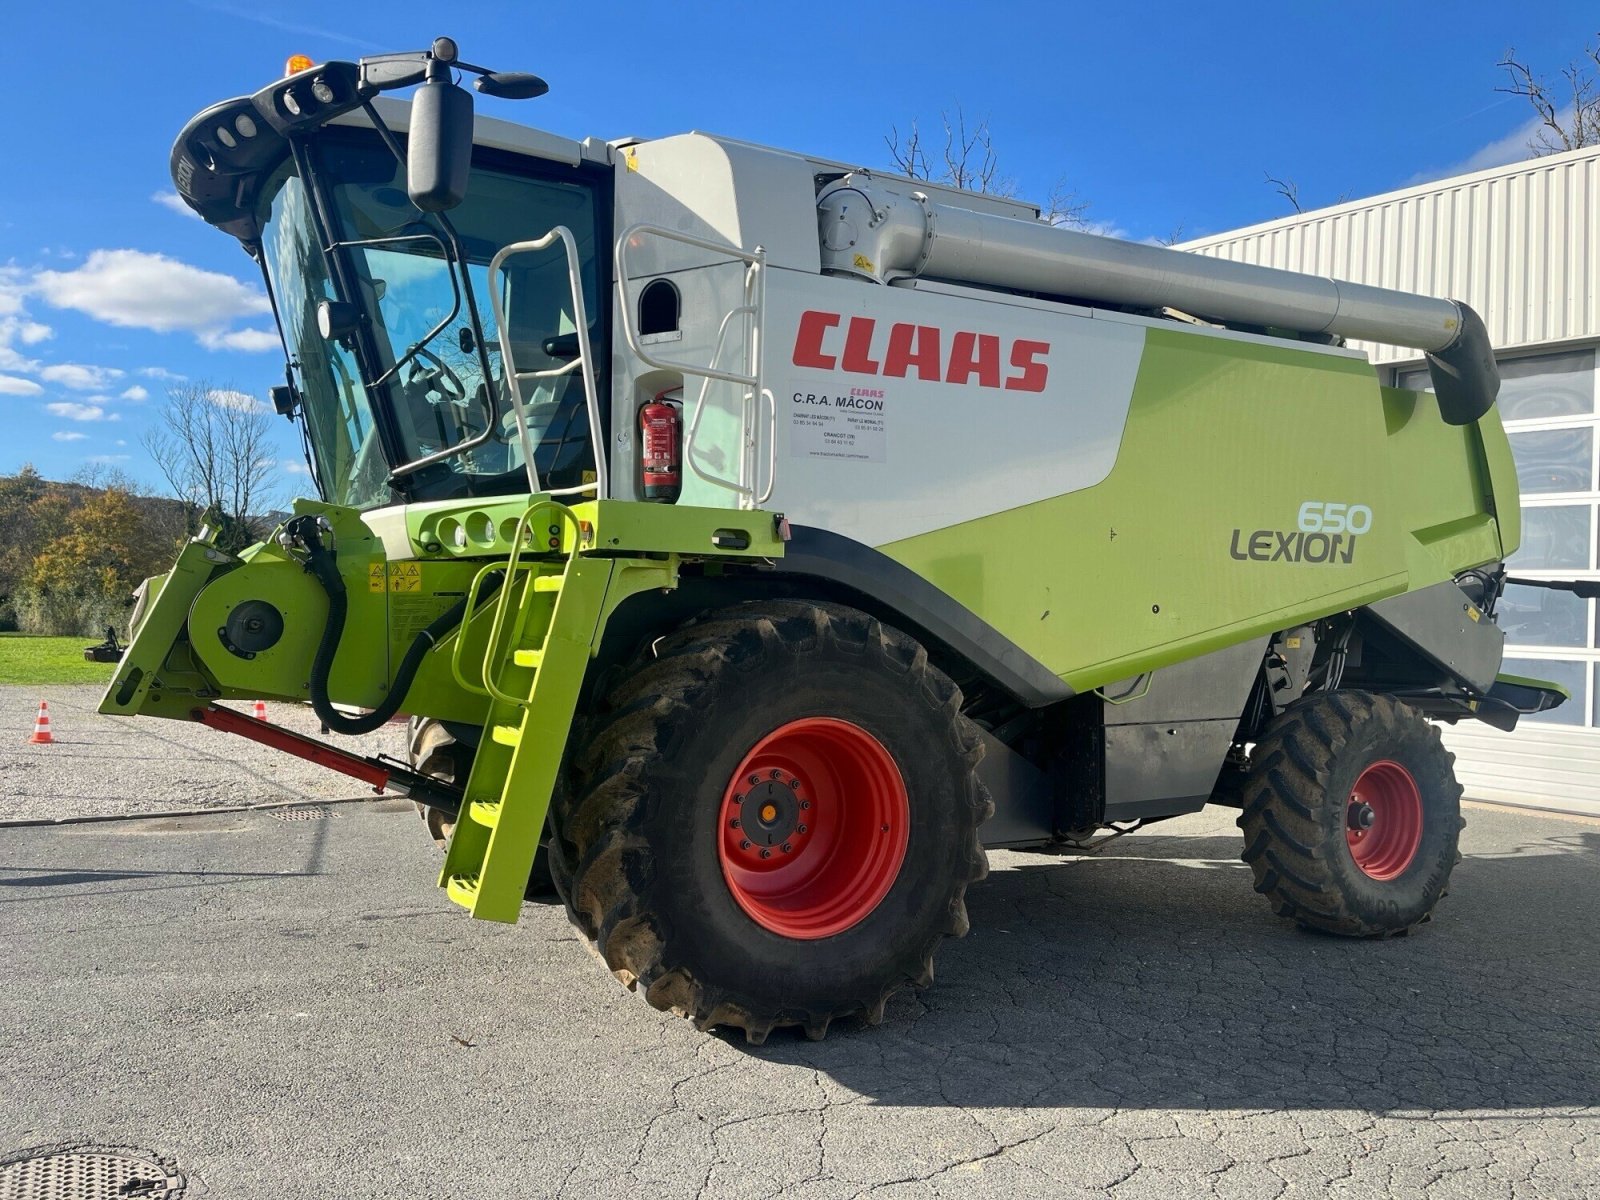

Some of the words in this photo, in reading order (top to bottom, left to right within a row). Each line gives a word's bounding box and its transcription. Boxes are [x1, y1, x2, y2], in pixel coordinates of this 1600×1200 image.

[792, 310, 1051, 393] CLAAS
[793, 392, 832, 406] C.R.A.
[835, 395, 884, 411] MÂCON
[850, 387, 885, 399] CLAAS
[823, 431, 846, 439] CRANCOT
[1297, 501, 1373, 535] 650
[1230, 529, 1356, 564] LEXION
